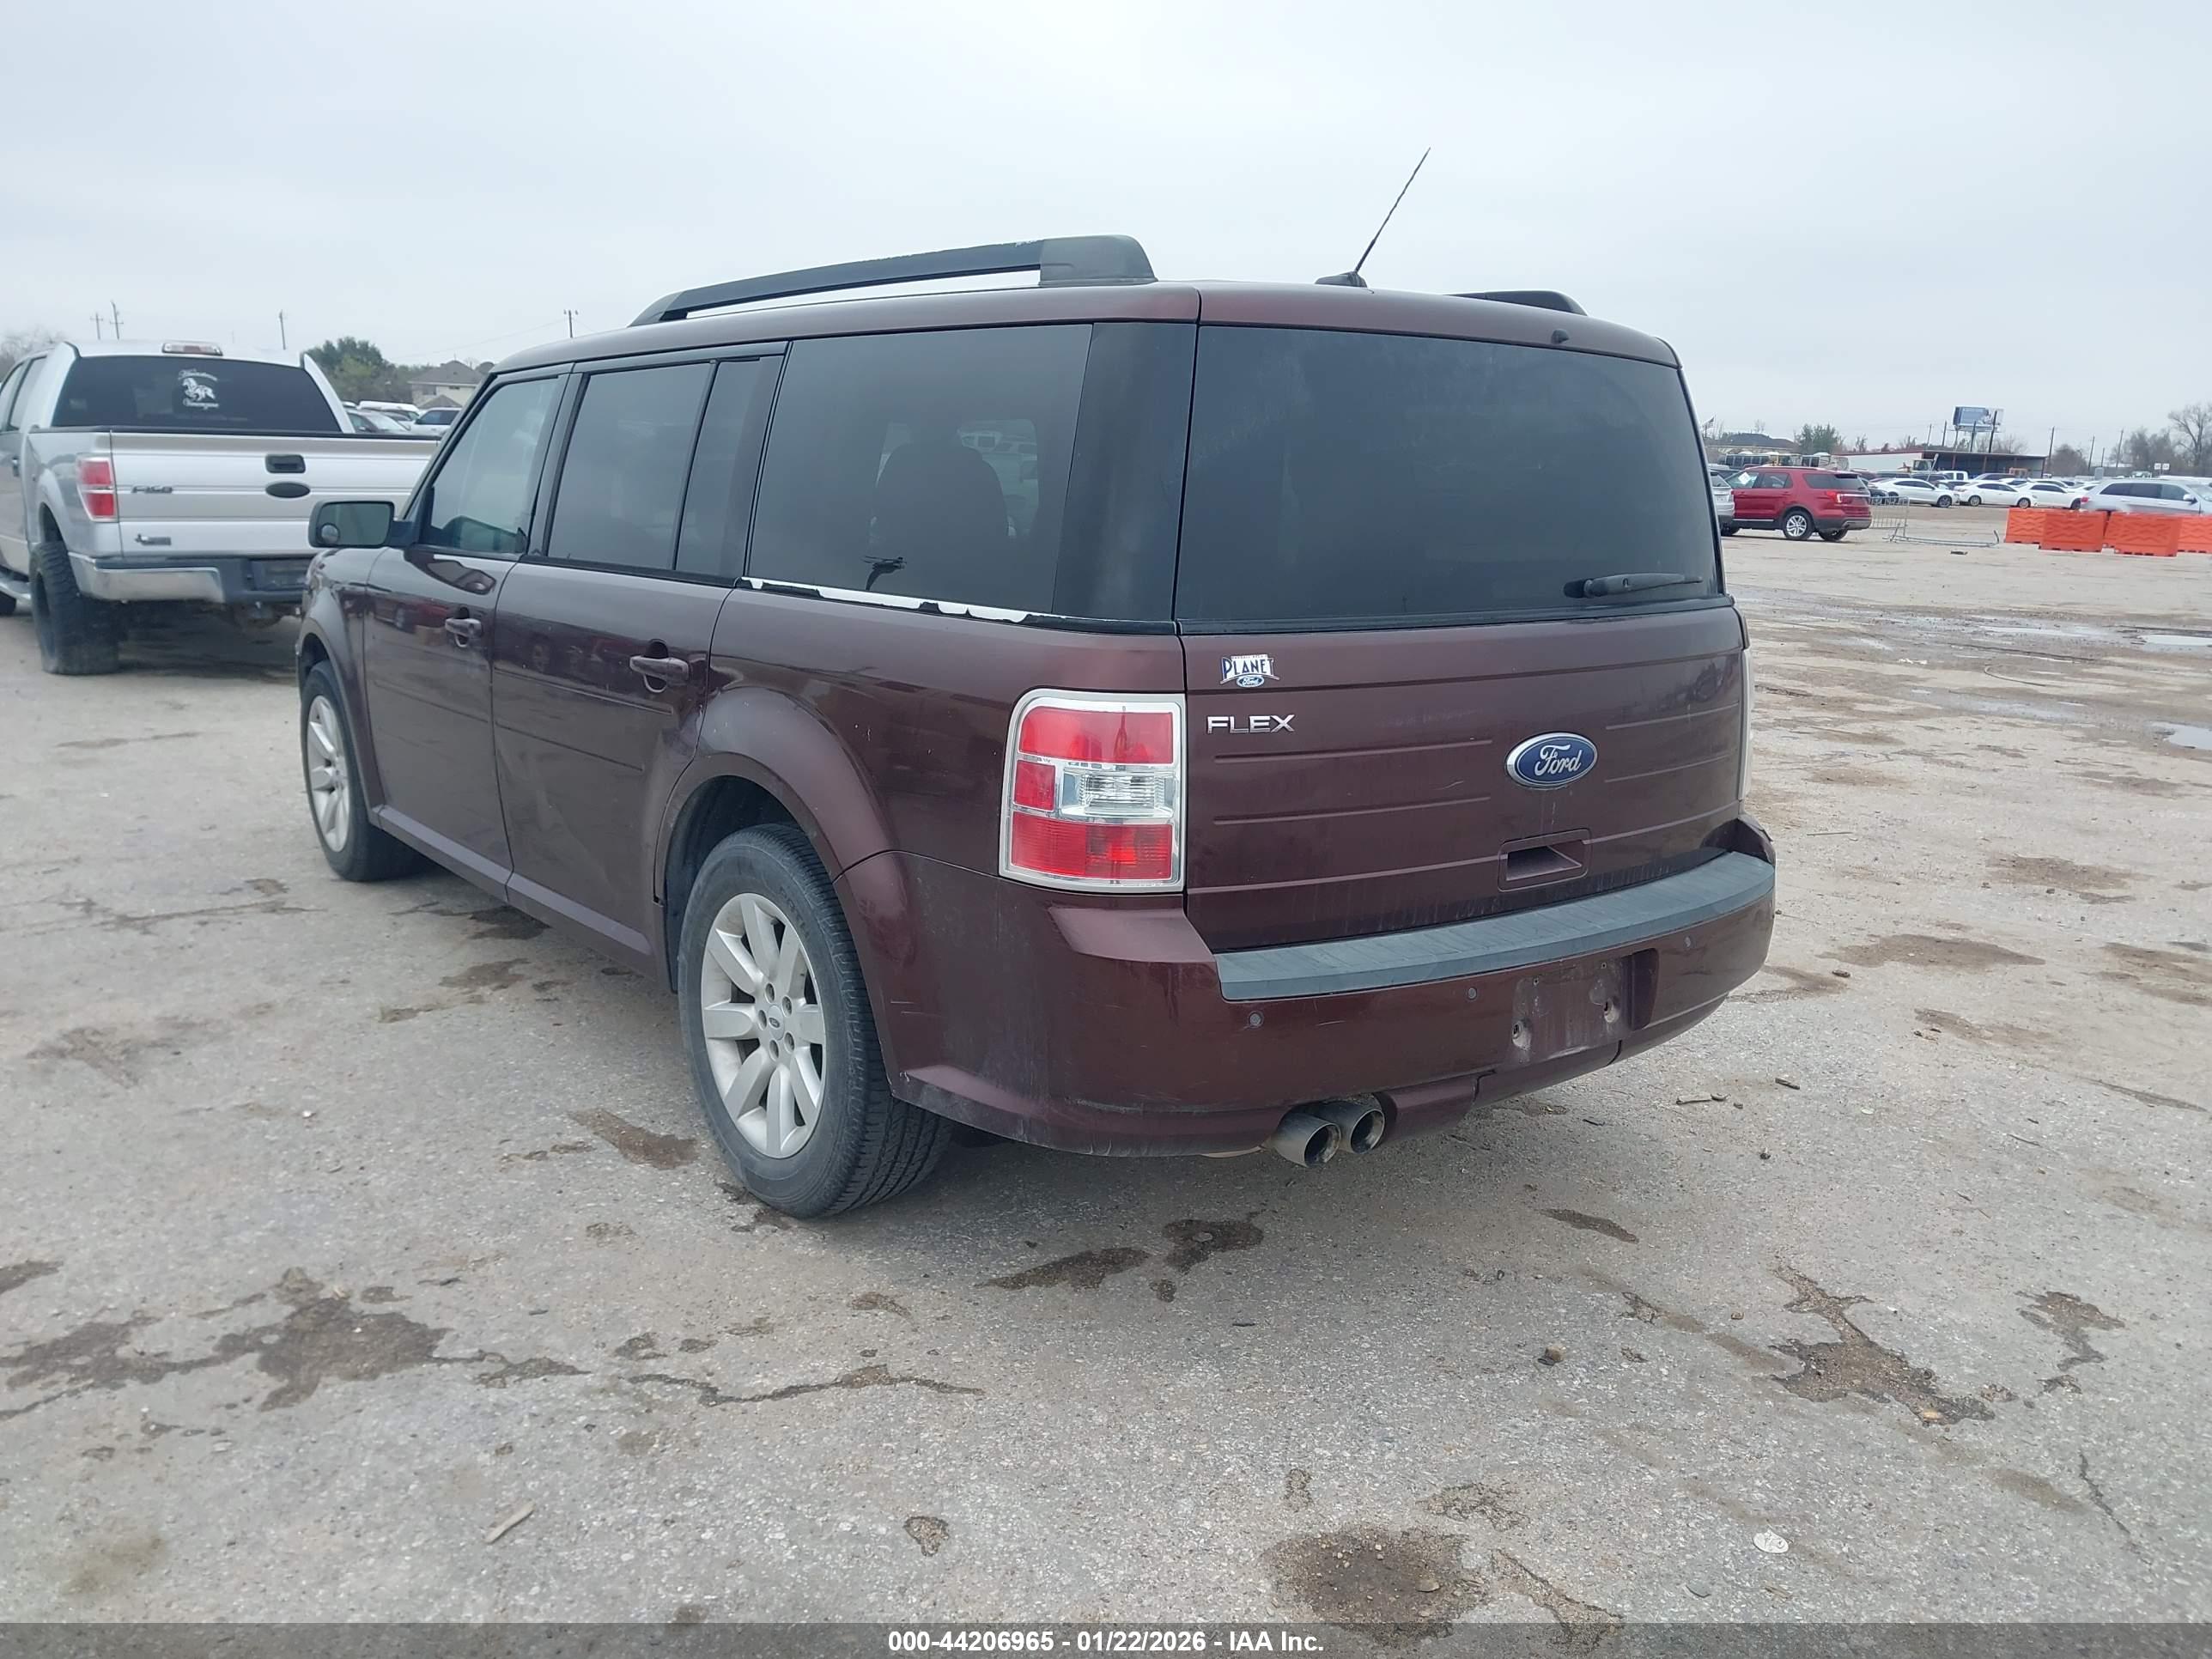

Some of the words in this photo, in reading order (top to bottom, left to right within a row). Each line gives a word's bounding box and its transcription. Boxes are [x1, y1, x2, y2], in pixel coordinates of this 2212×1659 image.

[1222, 657, 1274, 680] PLANET
[1207, 714, 1295, 733] FLEX
[1534, 744, 1582, 776] Ford
